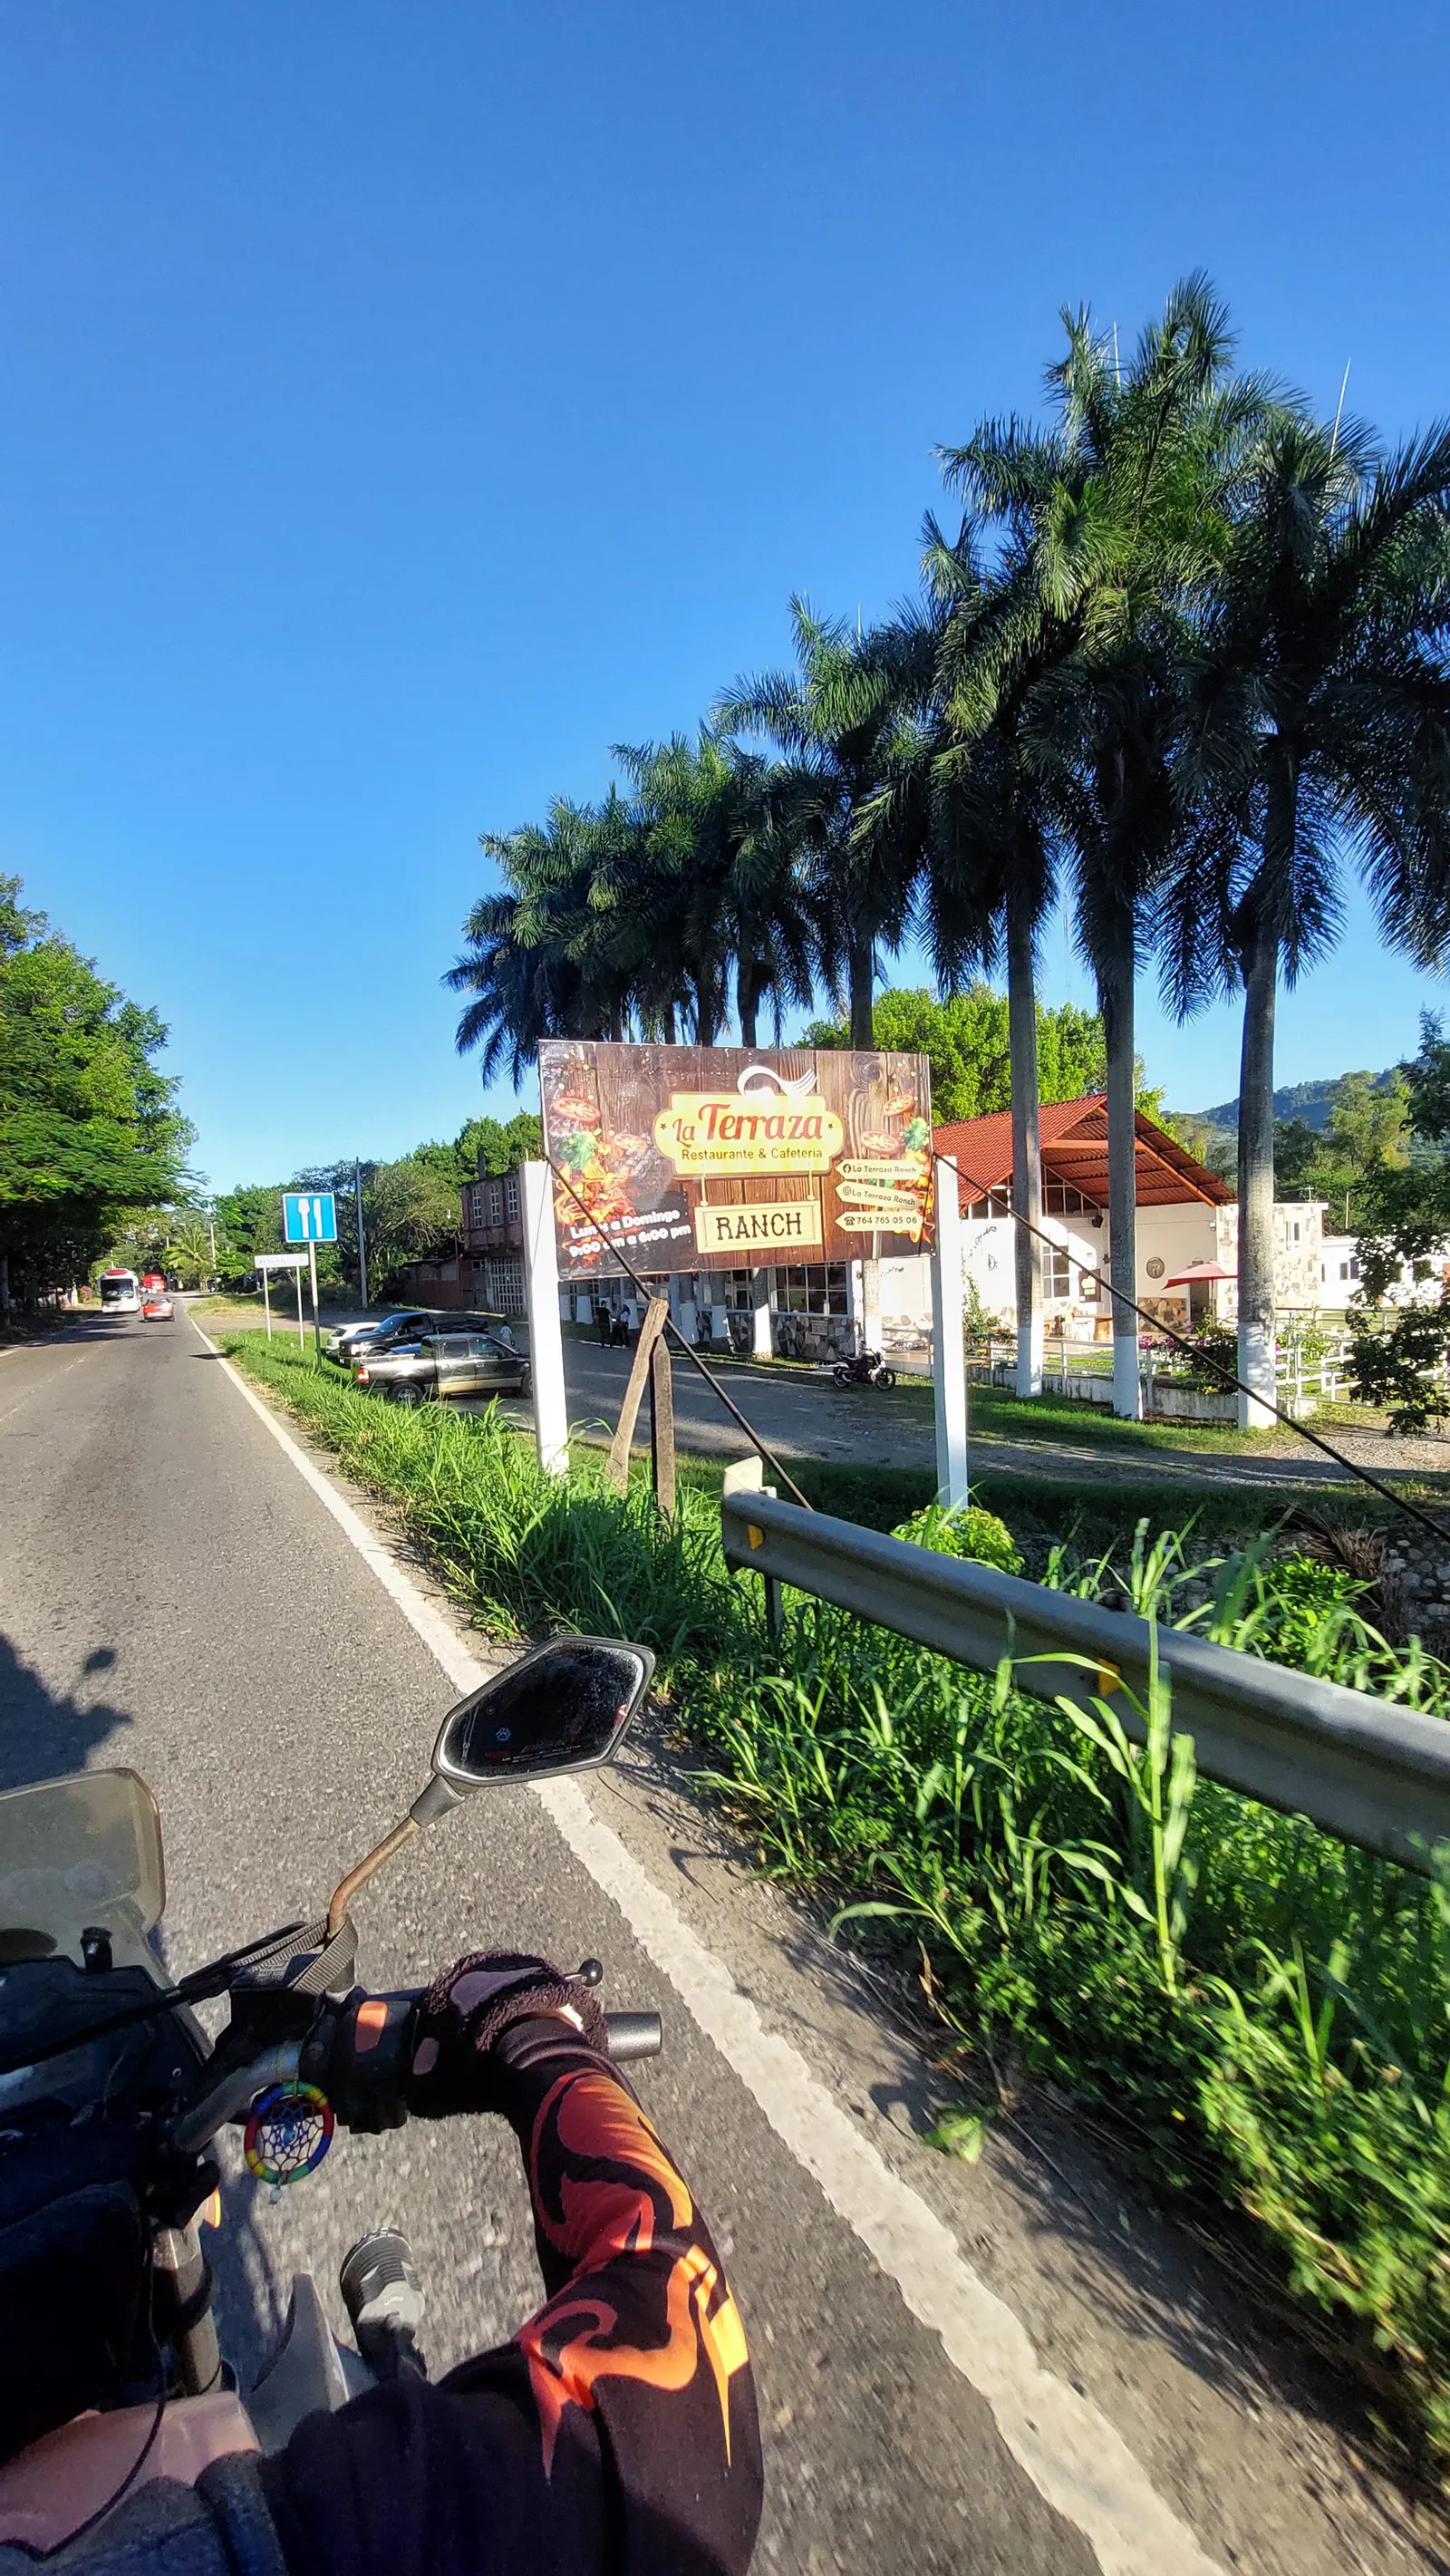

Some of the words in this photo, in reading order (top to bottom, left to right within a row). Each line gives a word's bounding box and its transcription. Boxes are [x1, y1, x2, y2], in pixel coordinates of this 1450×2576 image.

[672, 1119, 695, 1148] La
[698, 1103, 823, 1141] Terraza
[682, 1148, 754, 1160] Restaurante
[758, 1148, 767, 1159] &
[864, 1165, 893, 1173] Terraza
[852, 1188, 862, 1197] La
[865, 1191, 892, 1201] Terraza
[894, 1196, 915, 1206] Ranch
[570, 1222, 609, 1239] Luns
[610, 1220, 622, 1231] a
[622, 1210, 681, 1229] Domingo
[716, 1212, 803, 1241] RANCH
[856, 1216, 873, 1225] 764
[875, 1216, 890, 1225] 765
[569, 1241, 601, 1258] 9:00
[626, 1235, 637, 1245] a
[638, 1228, 669, 1243] 6:00
[669, 1225, 691, 1240] pm
